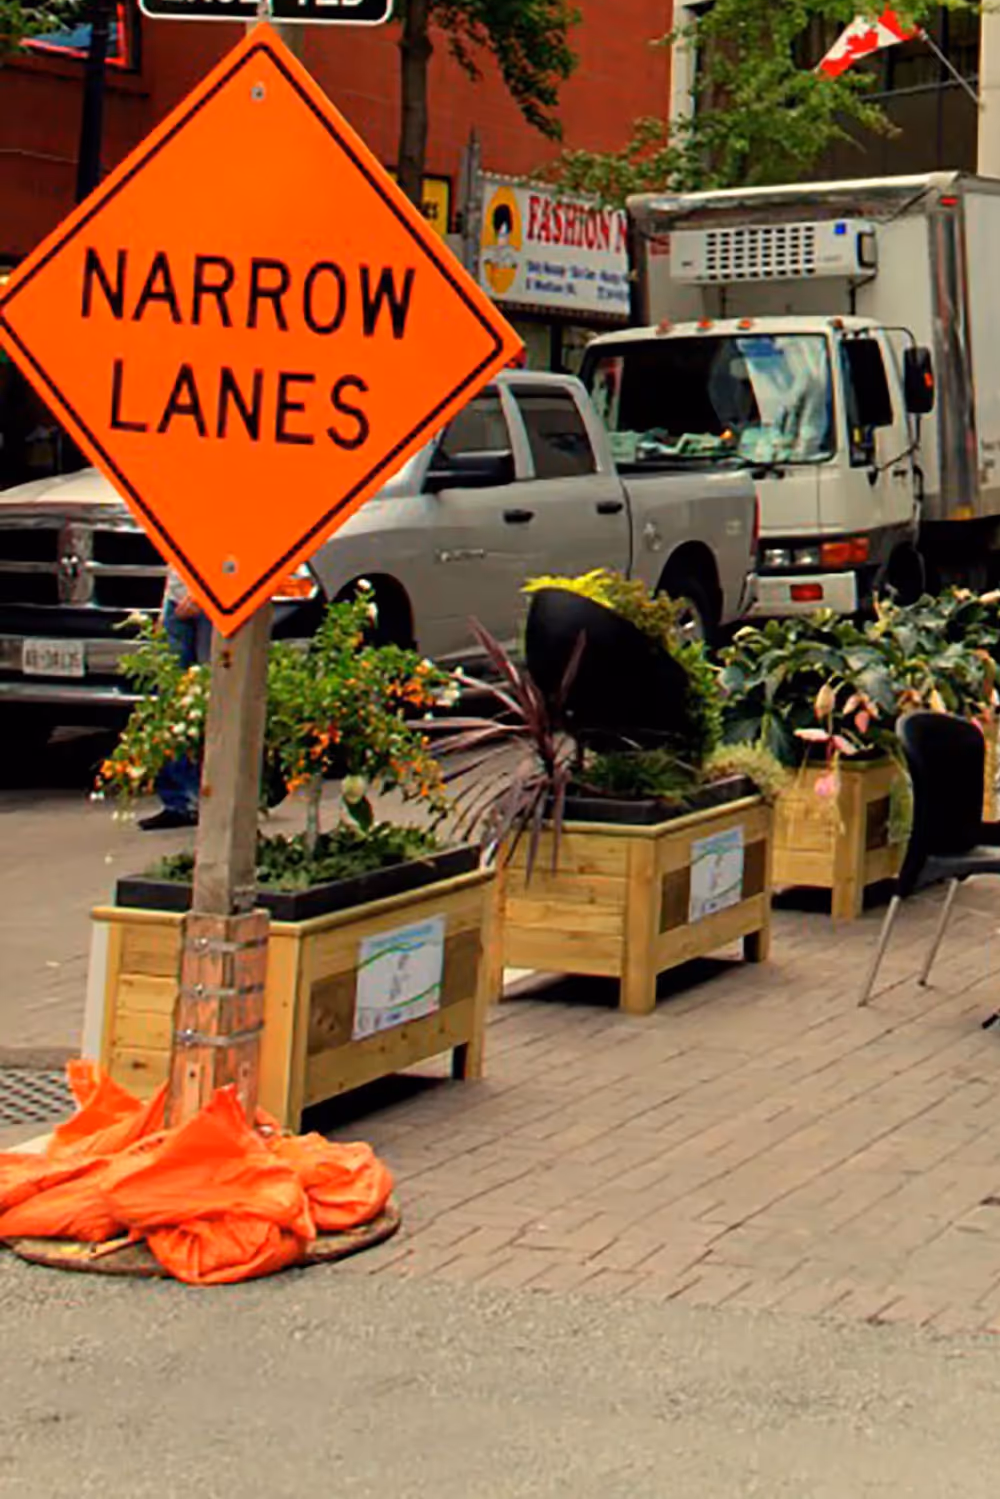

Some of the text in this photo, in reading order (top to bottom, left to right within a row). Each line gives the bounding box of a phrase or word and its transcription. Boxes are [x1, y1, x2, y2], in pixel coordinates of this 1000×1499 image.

[527, 195, 612, 251] FASHION
[80, 245, 416, 341] NARROW
[108, 357, 372, 452] LANES
